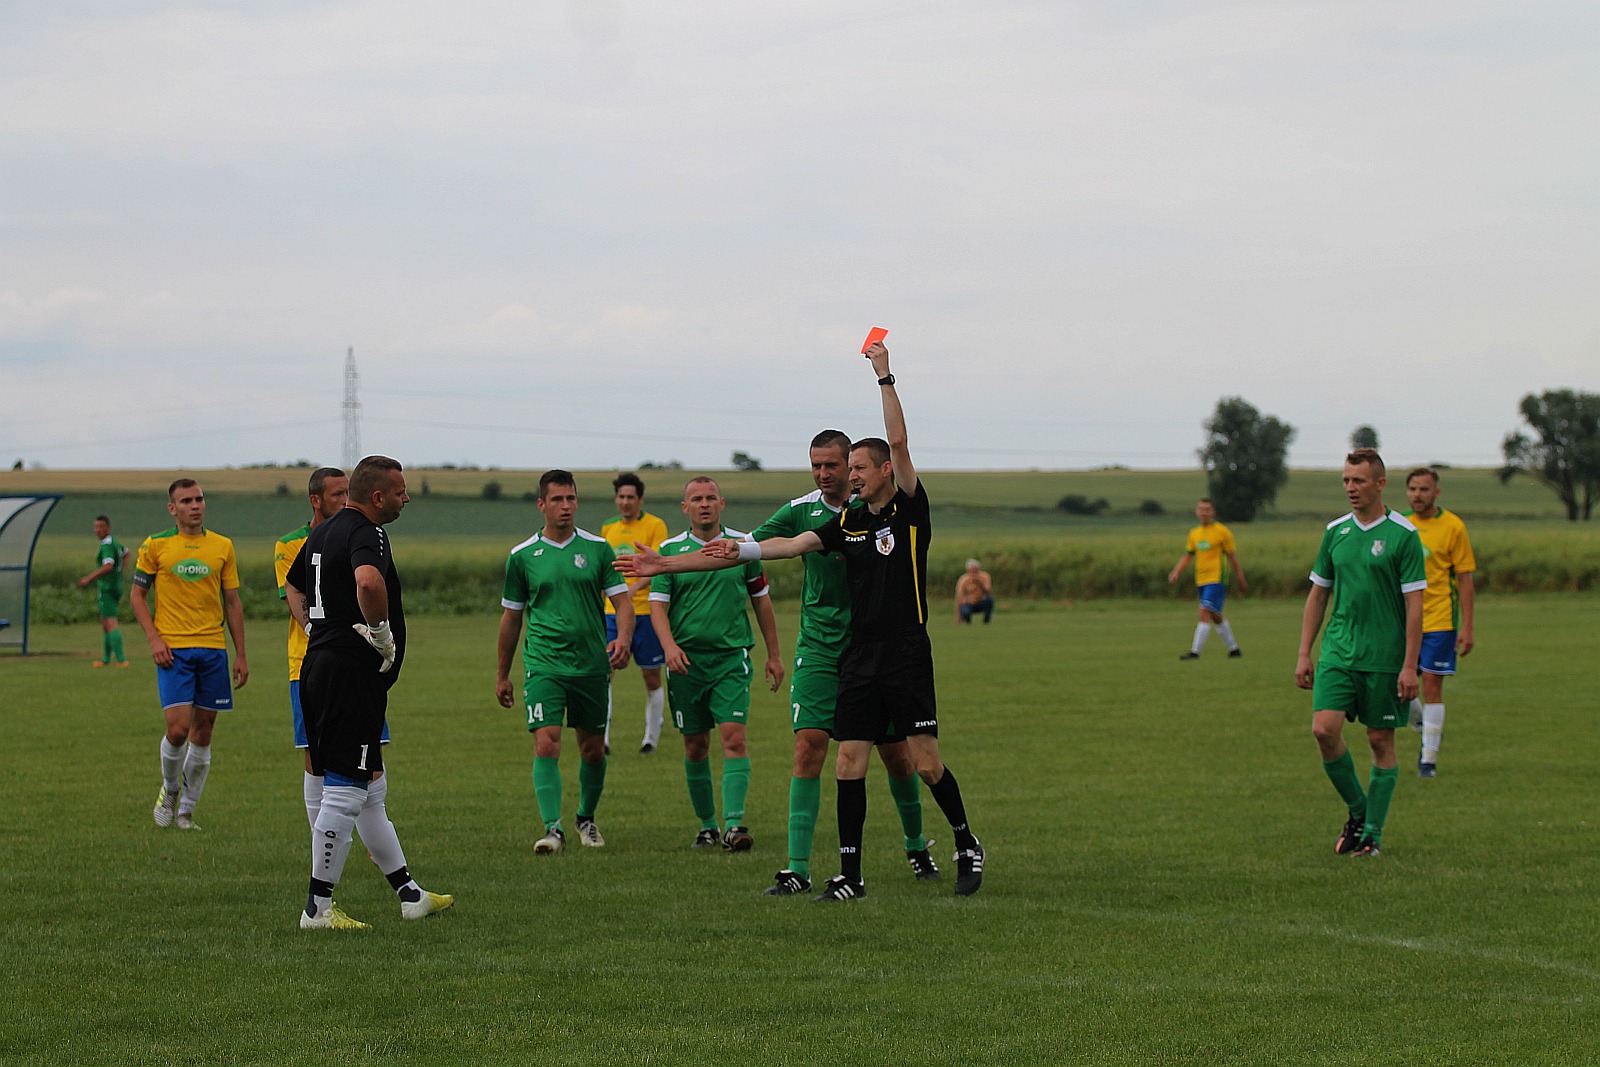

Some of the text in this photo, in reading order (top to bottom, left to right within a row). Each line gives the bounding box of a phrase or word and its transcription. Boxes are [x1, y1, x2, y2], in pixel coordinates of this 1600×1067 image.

[309, 552, 325, 619] 1
[527, 702, 544, 724] 14
[357, 744, 369, 771] 1
